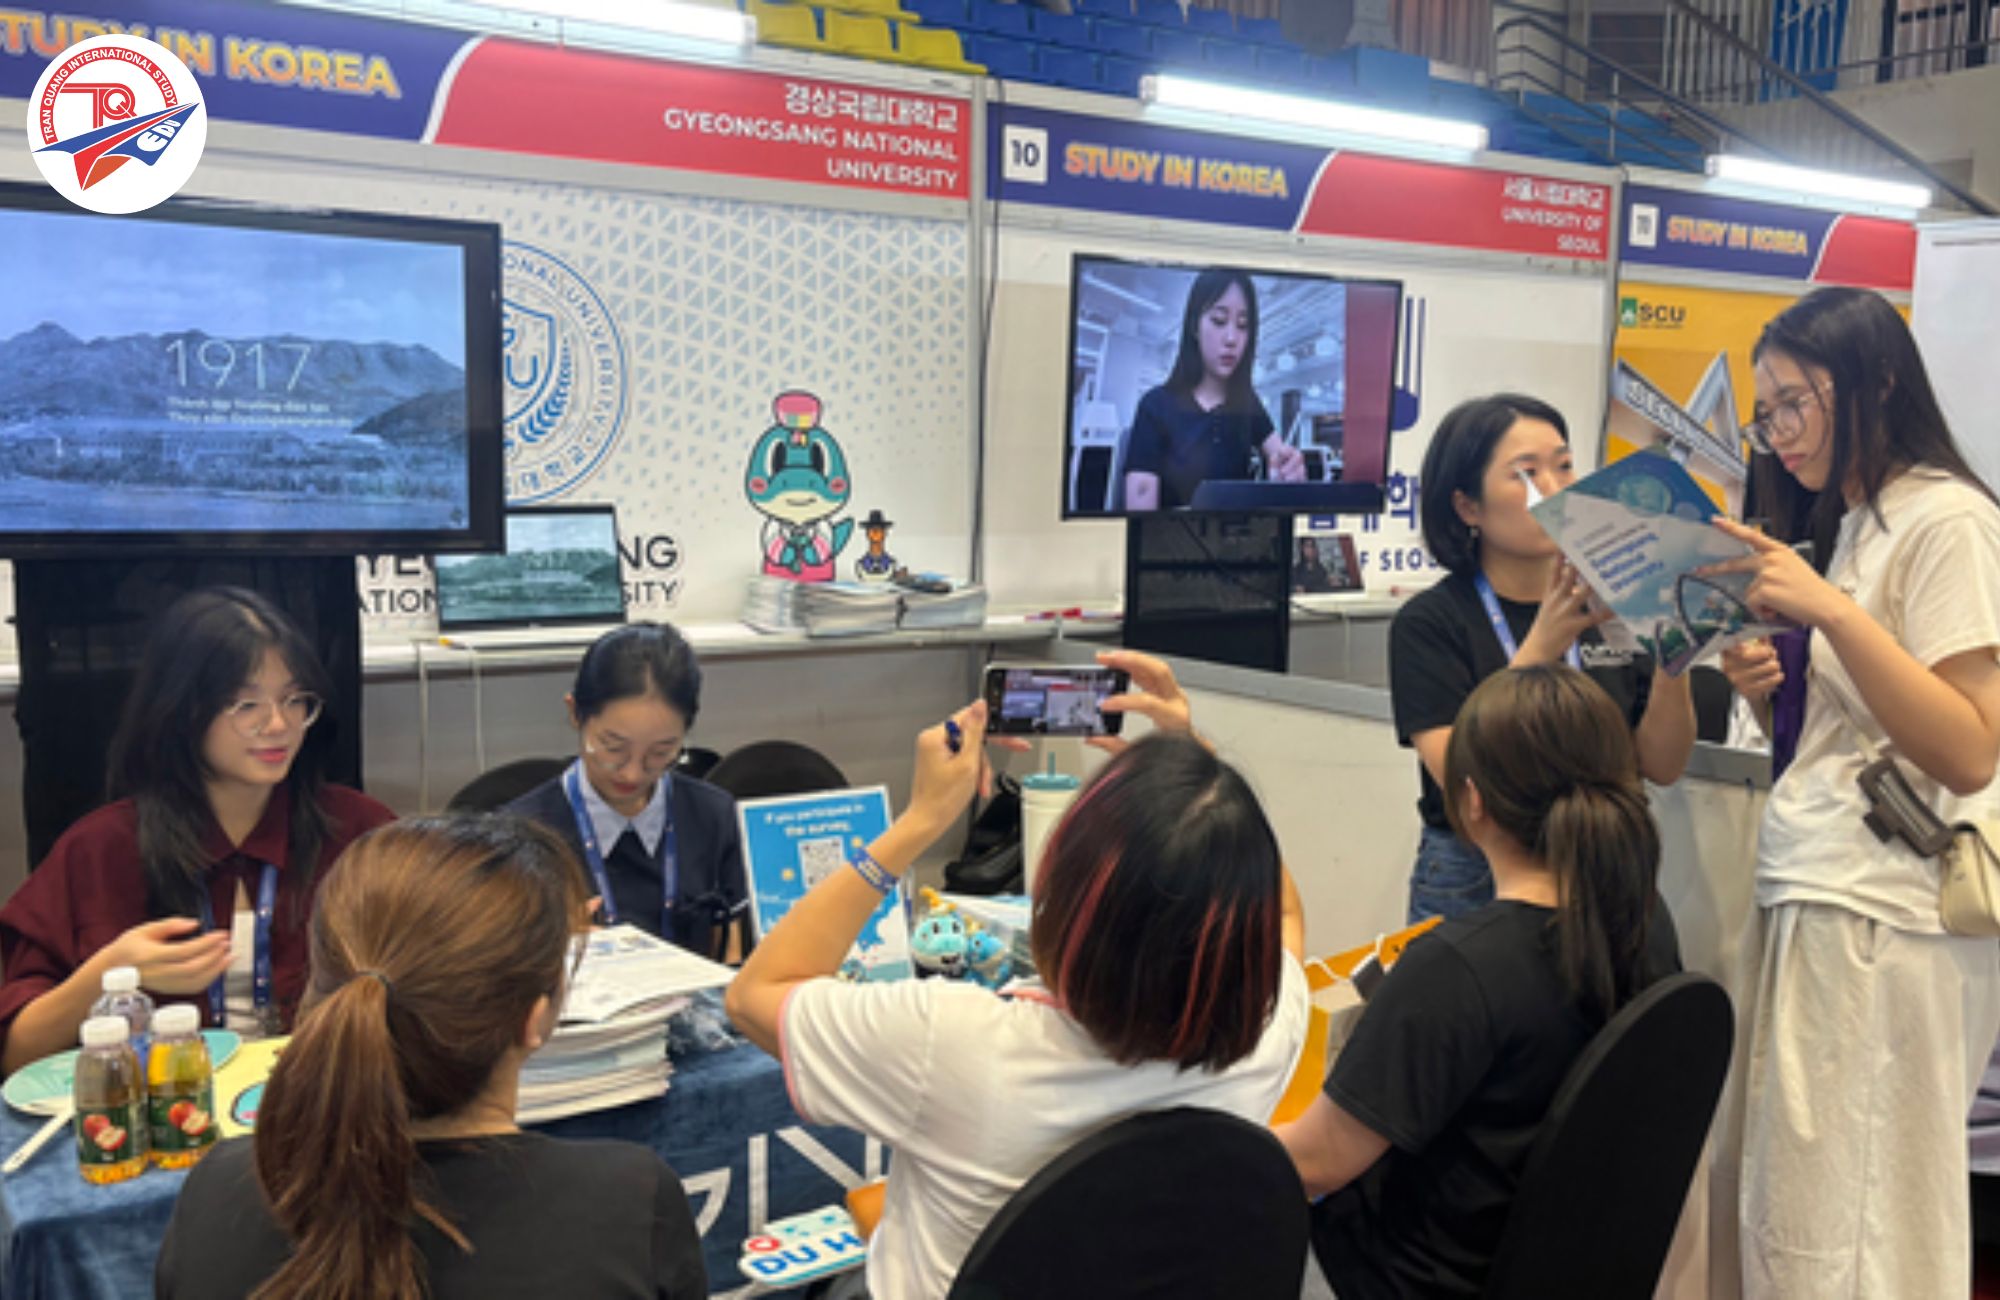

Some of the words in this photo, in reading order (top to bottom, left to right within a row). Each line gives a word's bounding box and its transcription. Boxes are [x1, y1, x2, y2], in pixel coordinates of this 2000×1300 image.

[223, 35, 402, 99] KOREA
[663, 108, 837, 148] GYEONGSANG
[843, 131, 958, 162] NATIONAL
[827, 157, 958, 189] UNIVERSITY
[1010, 139, 1040, 167] 10
[1064, 141, 1161, 183] STUDY
[1163, 154, 1194, 188] IN
[1198, 158, 1289, 199] KOREA
[1502, 206, 1581, 229] UNIVERSITY
[1584, 214, 1602, 231] OF
[1667, 215, 1727, 247] STUDY
[1728, 222, 1747, 249] IN
[1751, 226, 1807, 257] KOREA
[1556, 234, 1600, 254] SEOUL
[1640, 304, 1686, 322] SCU
[166, 339, 311, 391] 1917
[751, 1244, 819, 1274] DU
